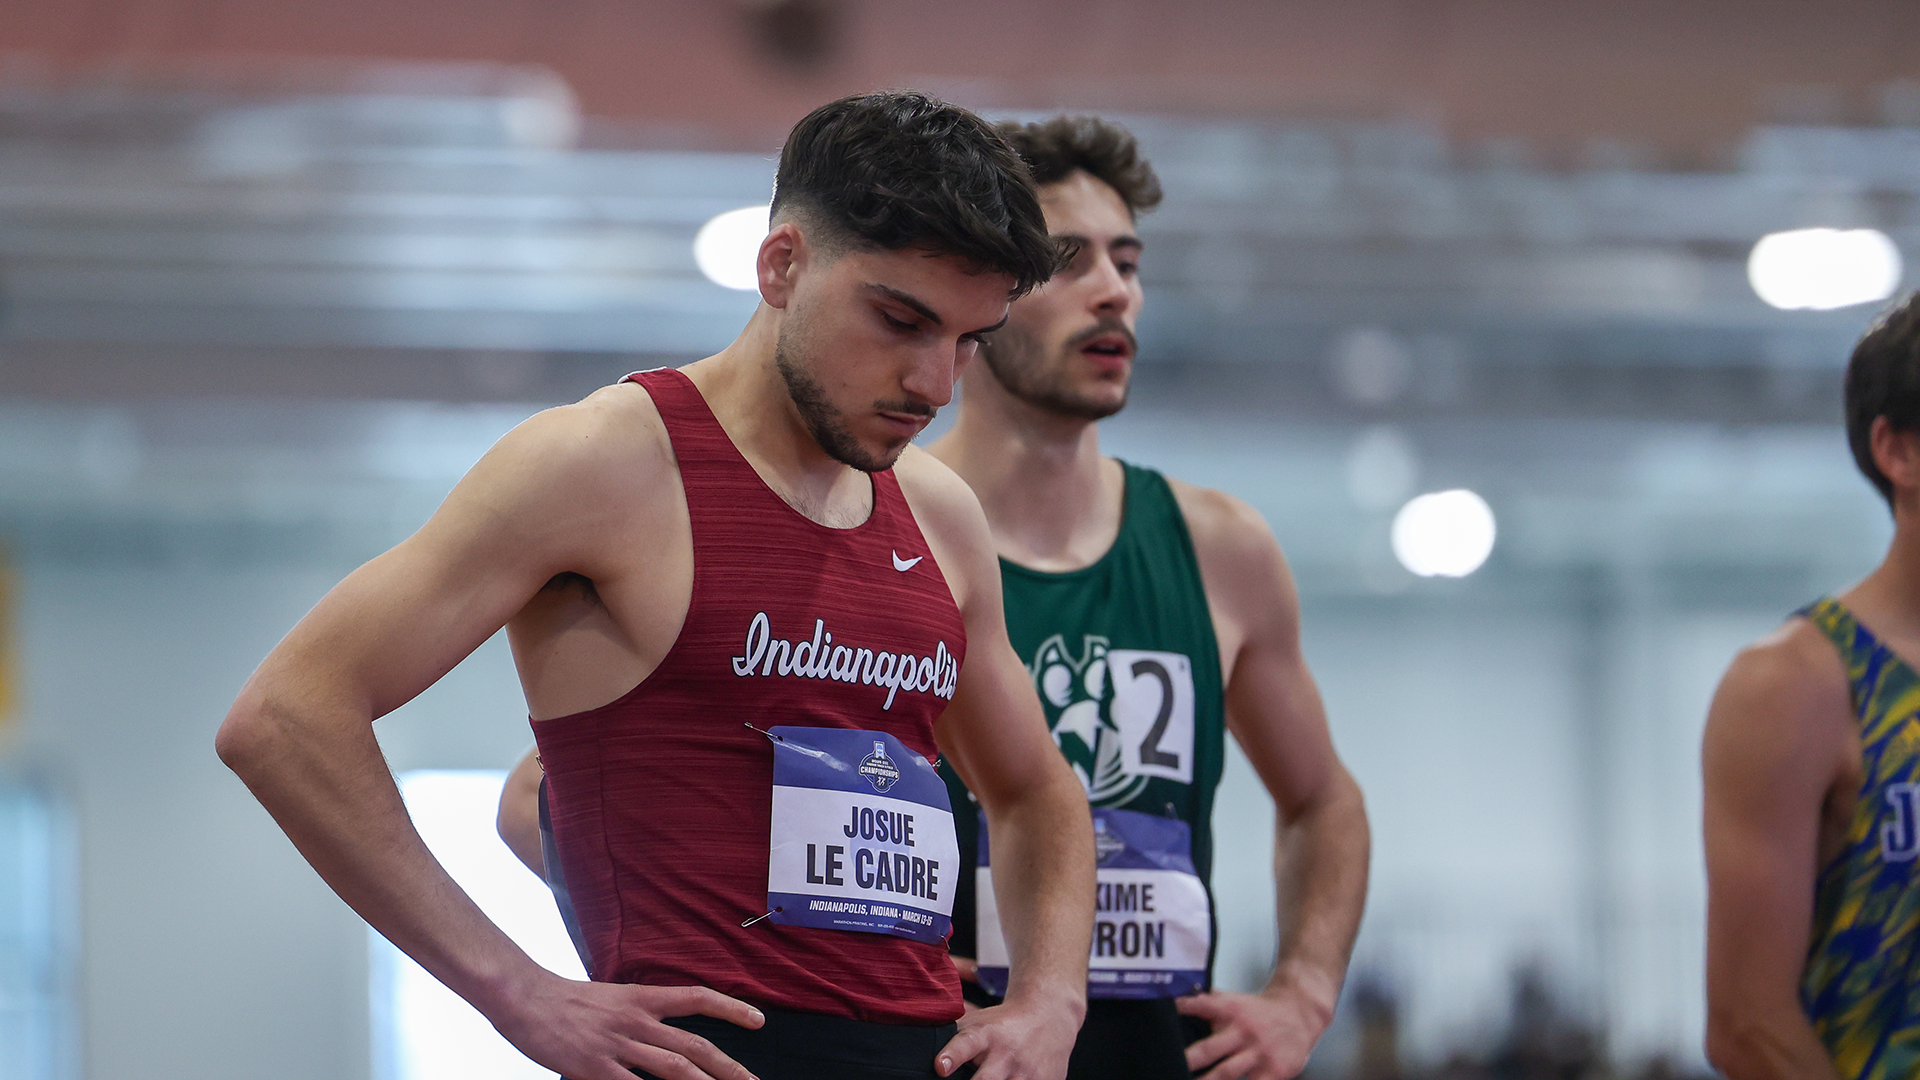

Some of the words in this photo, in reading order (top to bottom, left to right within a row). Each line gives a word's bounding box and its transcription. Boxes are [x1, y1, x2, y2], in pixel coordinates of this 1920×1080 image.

[732, 610, 958, 711] Indianapolis
[1130, 659, 1180, 771] 2
[860, 766, 899, 779] CHAMPIONSHIPS
[843, 806, 915, 847] JOSUE
[806, 844, 844, 886] LE
[855, 847, 939, 901] CADRE
[809, 900, 868, 916] INDIANAPOLIS,
[870, 905, 898, 919] INDIANA
[902, 909, 921, 923] MARCH
[1095, 921, 1164, 958] RON
